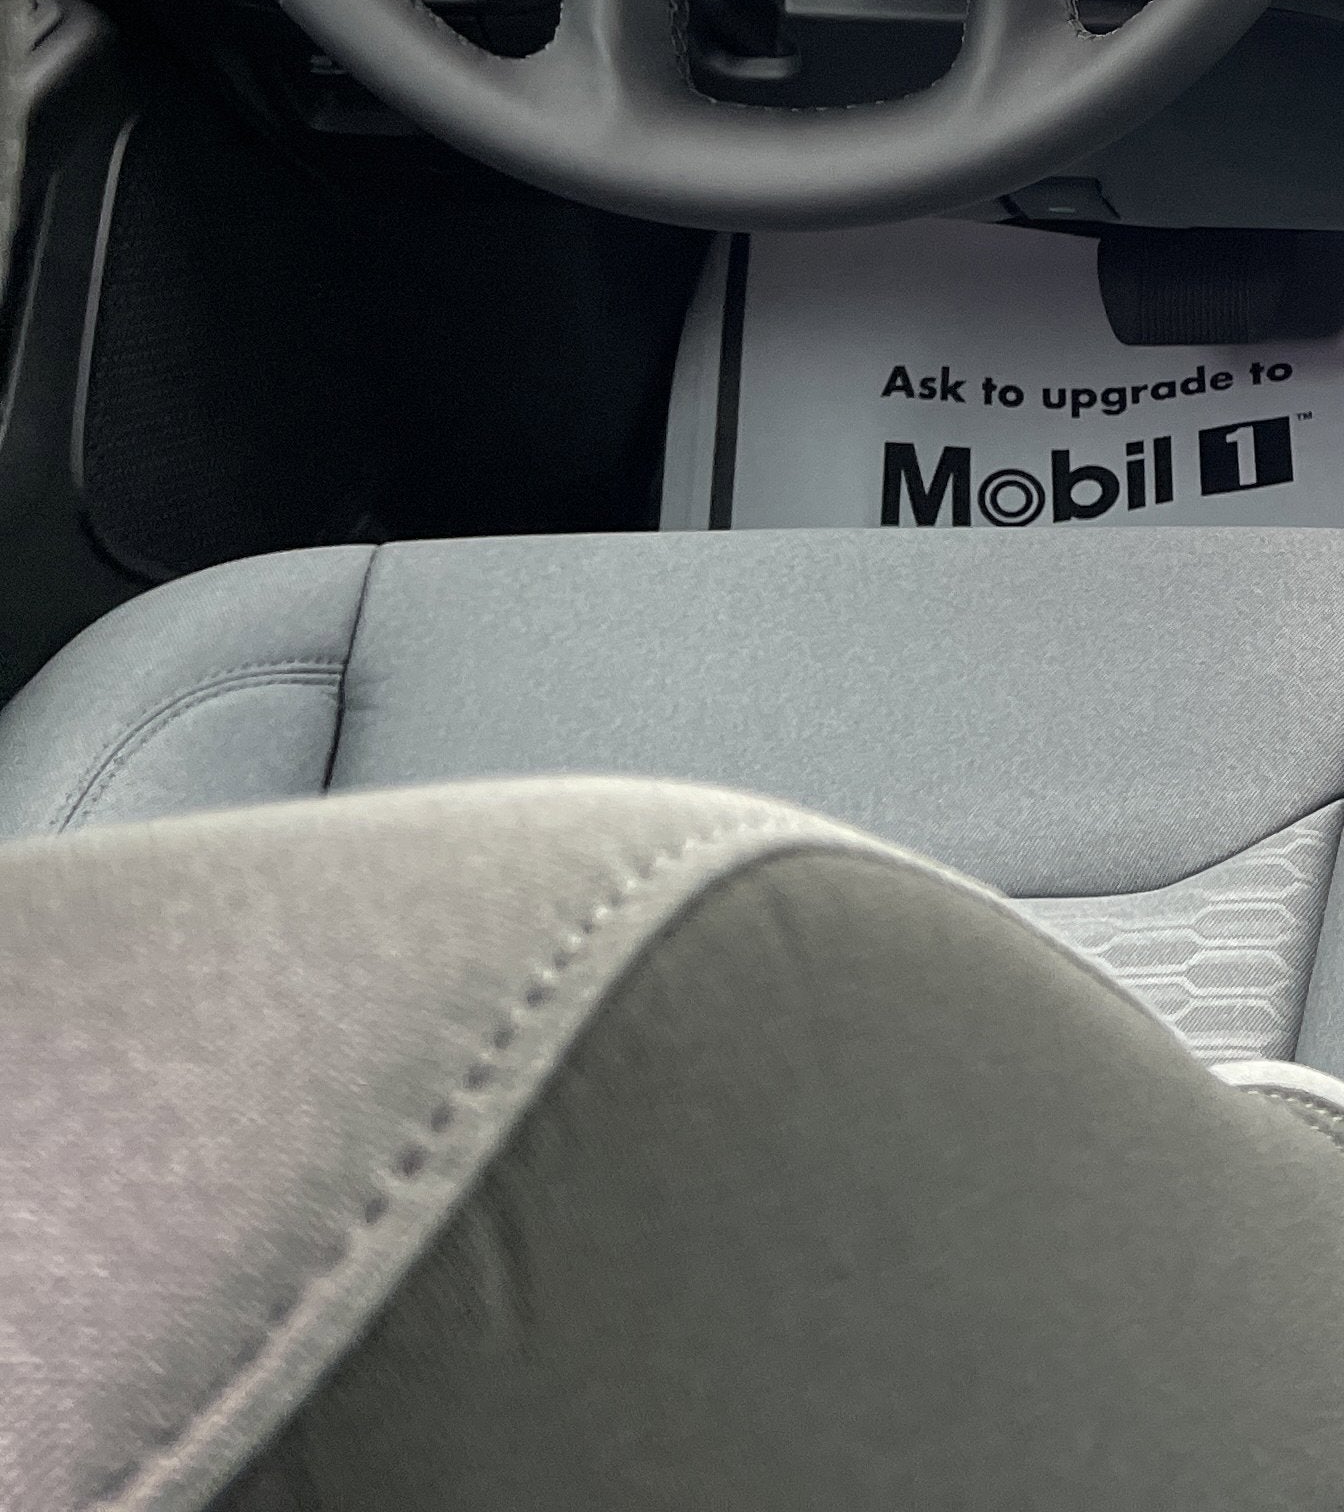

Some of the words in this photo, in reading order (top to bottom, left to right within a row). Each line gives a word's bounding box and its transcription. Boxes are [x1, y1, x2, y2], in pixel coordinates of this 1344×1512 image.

[880, 365, 967, 404] Ask
[982, 376, 1025, 408] to
[1042, 365, 1234, 419] upgrade
[1249, 361, 1294, 386] to
[880, 435, 1174, 527] Mobil
